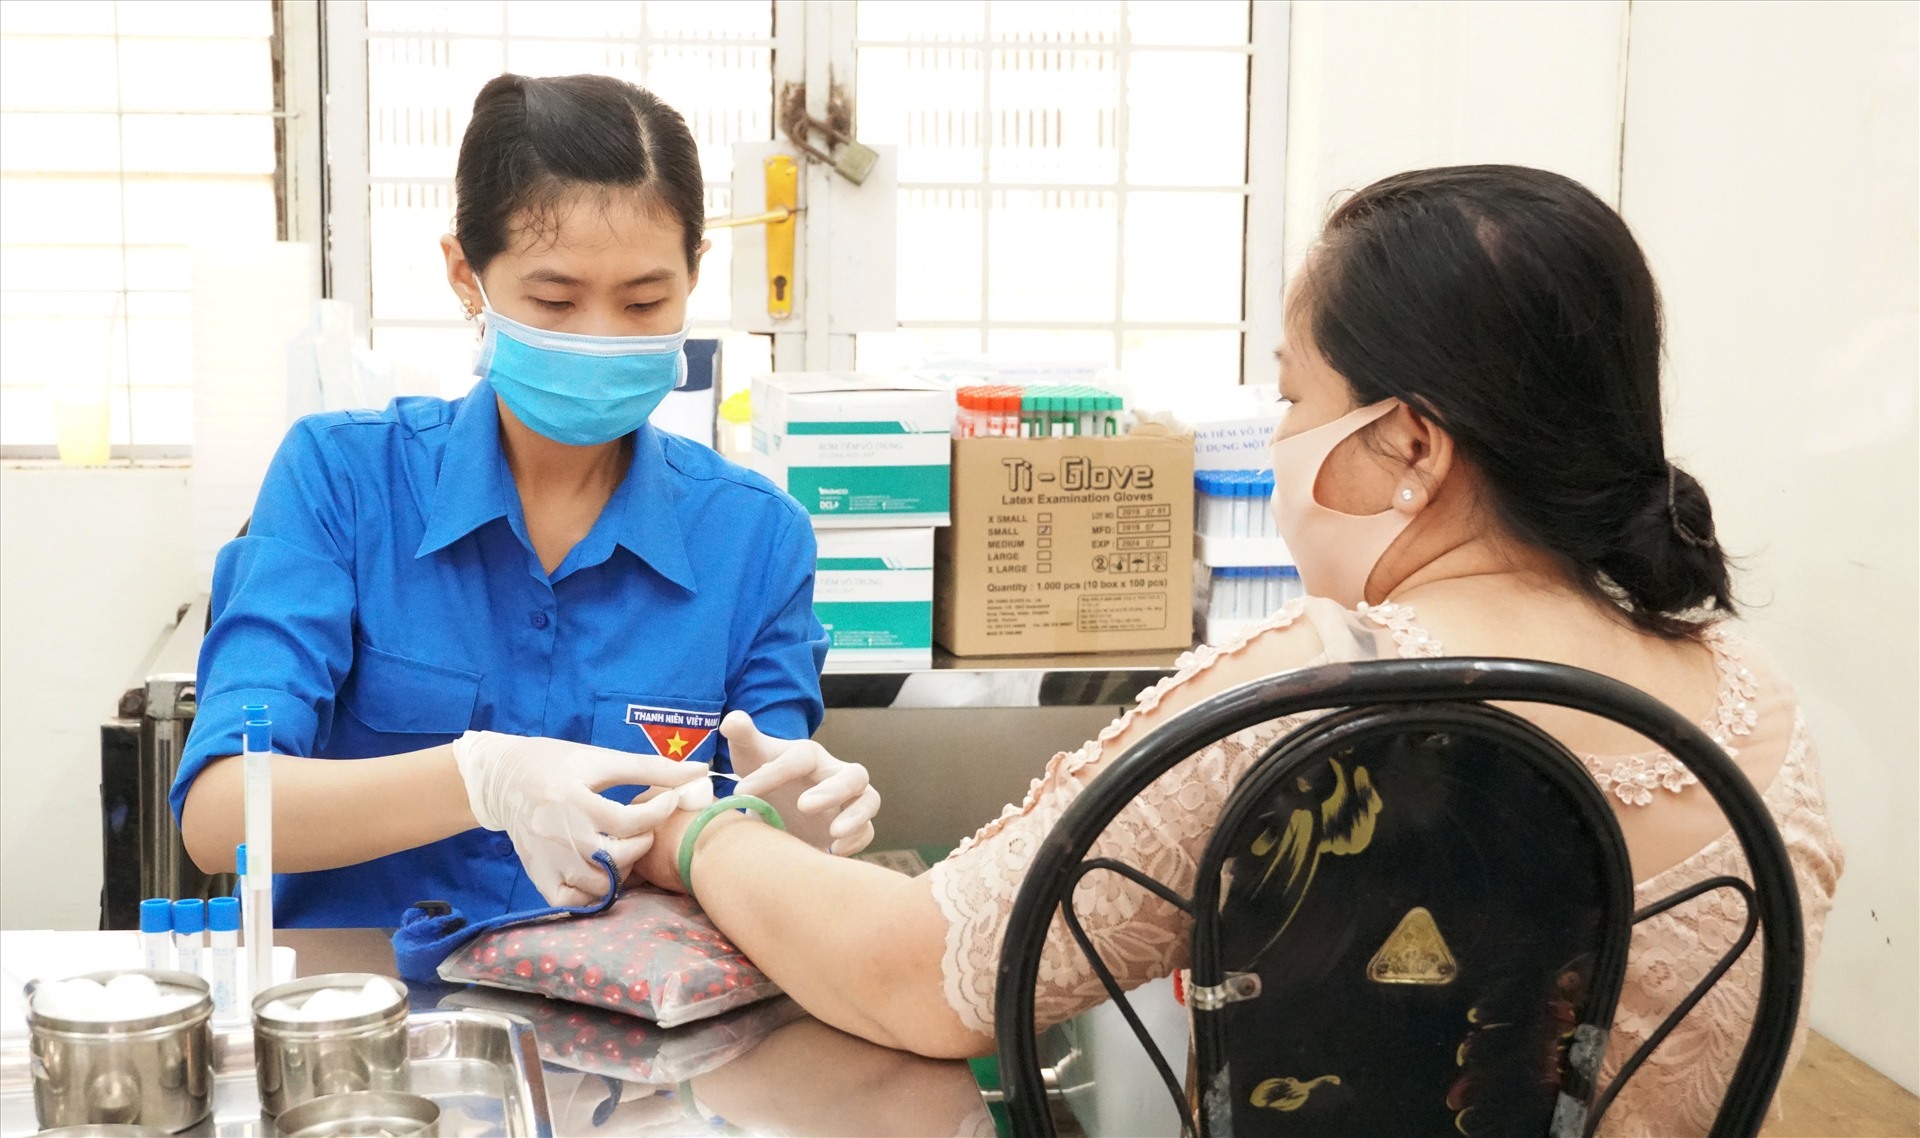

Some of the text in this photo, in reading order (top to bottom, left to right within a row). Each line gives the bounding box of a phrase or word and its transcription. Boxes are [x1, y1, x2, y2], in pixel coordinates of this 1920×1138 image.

[1002, 457, 1033, 492] Ti
[1060, 456, 1154, 491] Glove
[1001, 491, 1154, 505] Latex Examination Gloves
[996, 515, 1028, 523] SMALL
[987, 527, 1019, 536] SMALL
[987, 540, 1025, 549] MEDIUM
[987, 552, 1020, 561] LARGE
[987, 564, 1028, 574] X LARGE
[986, 583, 1027, 593] Quantity
[1064, 582, 1081, 592] pcs
[1083, 580, 1098, 590] (10
[1100, 579, 1118, 589] box
[1147, 578, 1168, 589] pcs)
[634, 711, 664, 722] THANH
[665, 713, 684, 725] NIÊN
[686, 714, 703, 728] VIỆT
